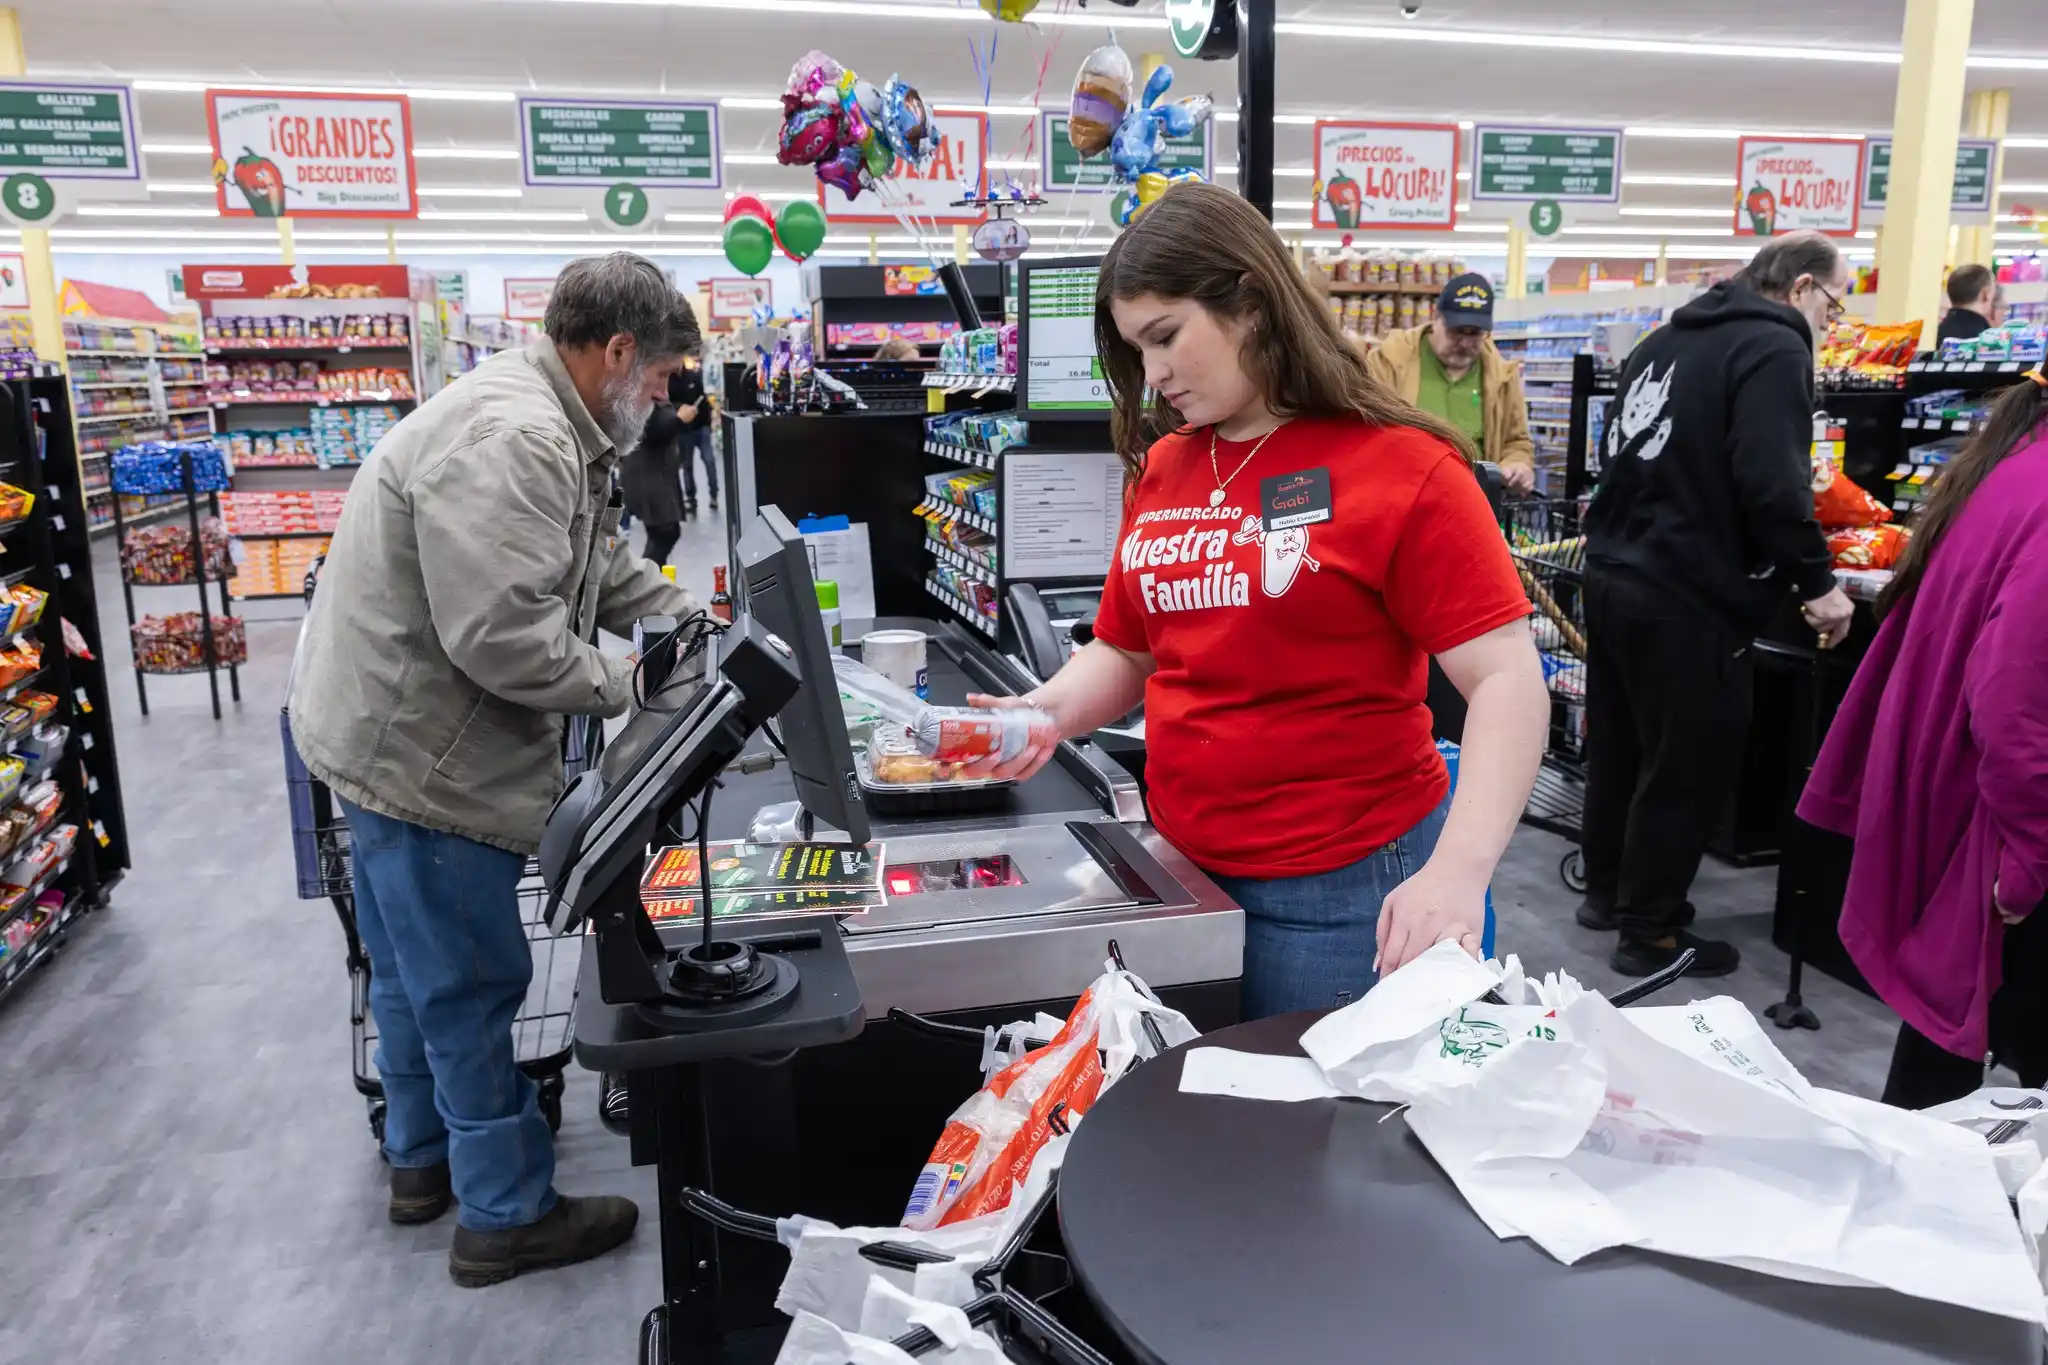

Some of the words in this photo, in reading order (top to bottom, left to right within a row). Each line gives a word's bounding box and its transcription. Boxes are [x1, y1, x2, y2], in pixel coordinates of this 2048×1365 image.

[269, 116, 396, 159] ¡GRANDES
[297, 165, 398, 184] DESCUENTOS!
[1365, 166, 1446, 203] LOCURA!
[17, 182, 40, 210] 8
[618, 191, 634, 216] 7
[1538, 206, 1552, 227] 5
[1272, 491, 1309, 510] Gabi
[1135, 507, 1243, 525] SUPERMERCADO
[1120, 524, 1229, 574] Nuestra
[1139, 561, 1250, 614] Familia
